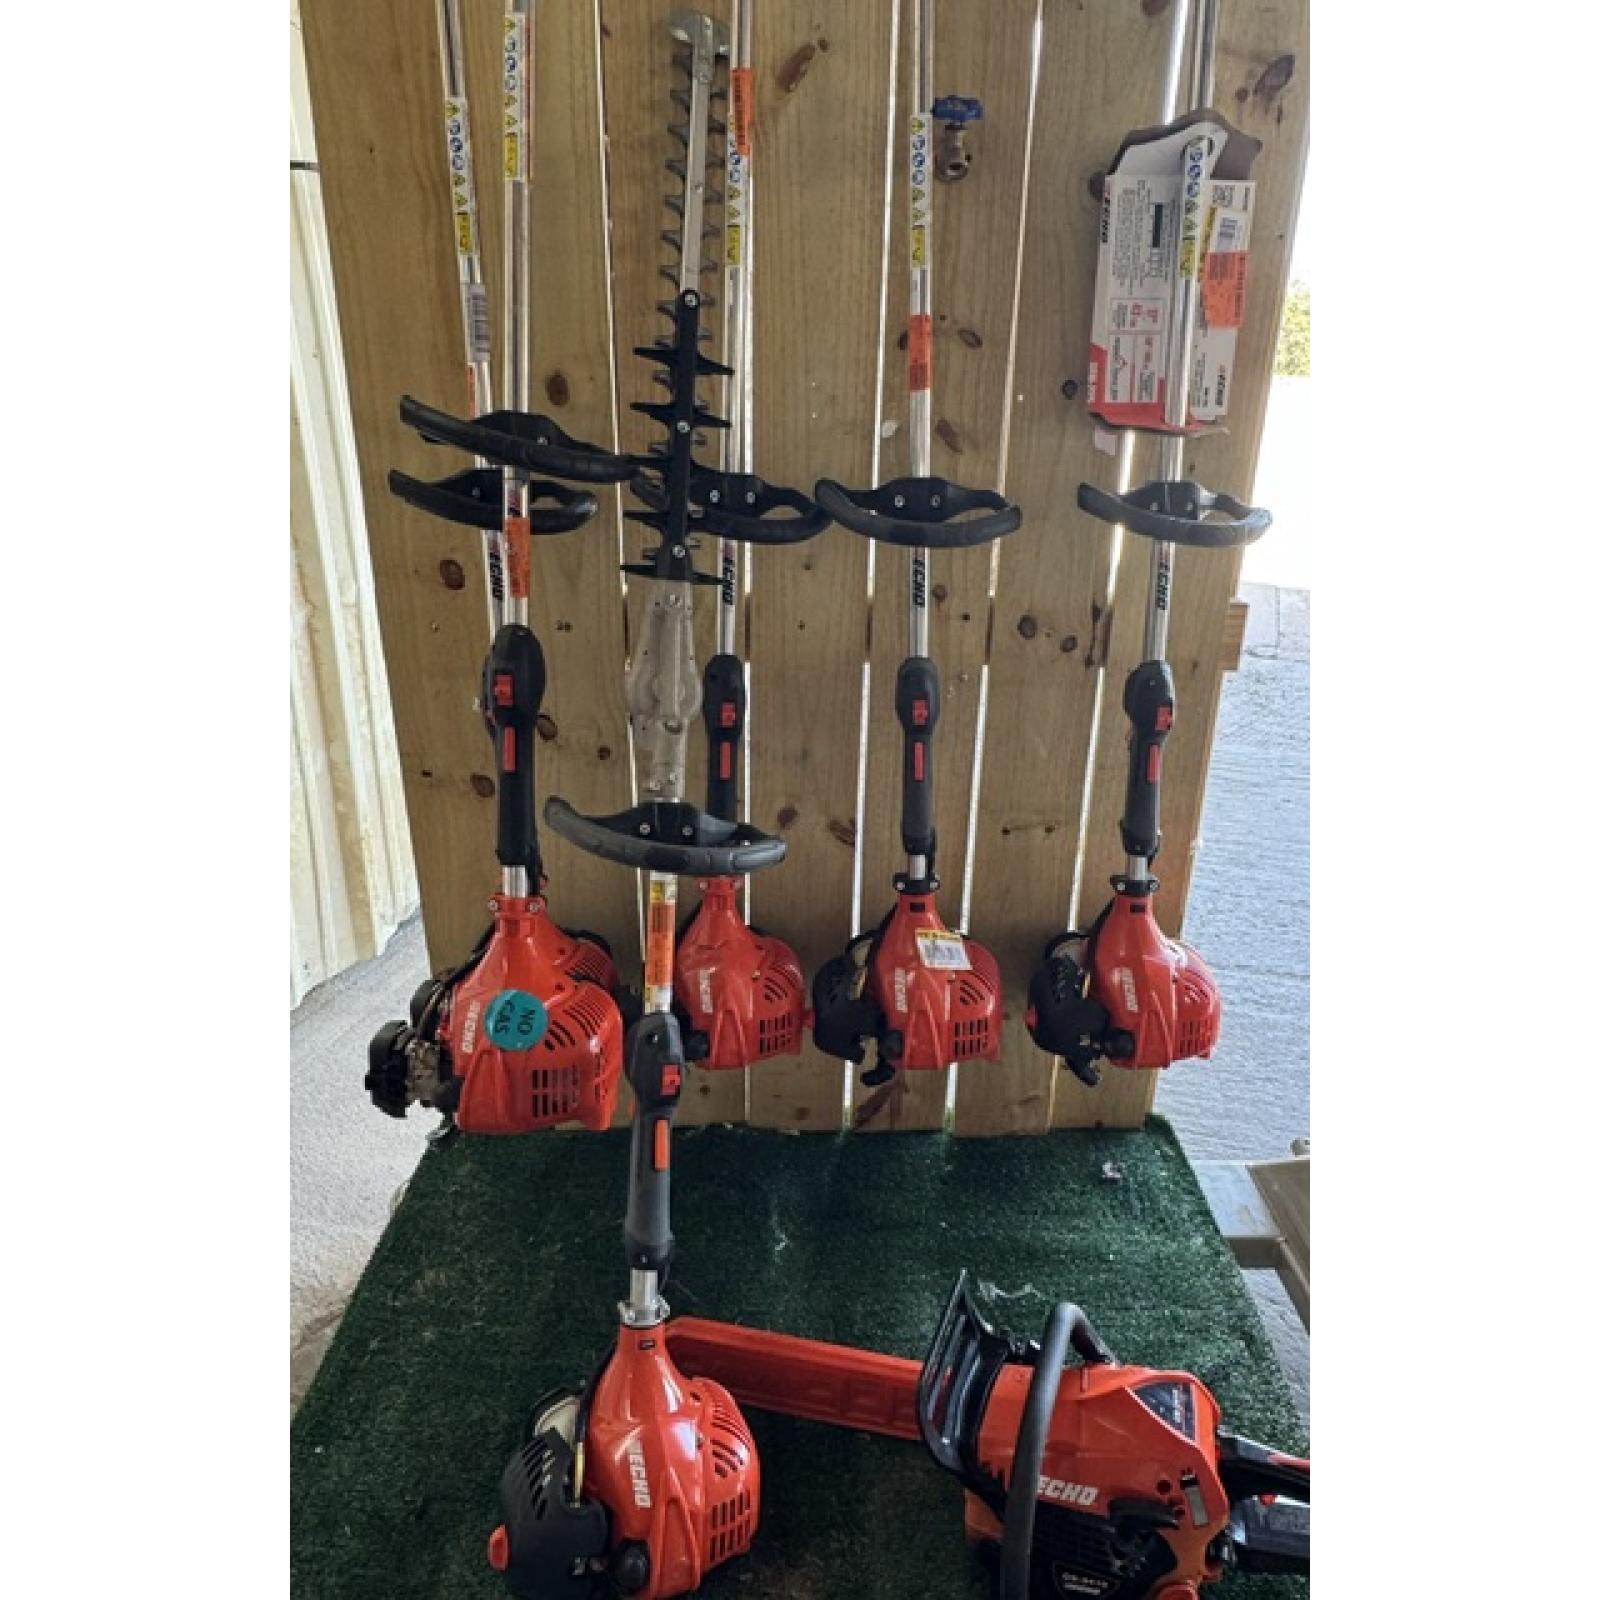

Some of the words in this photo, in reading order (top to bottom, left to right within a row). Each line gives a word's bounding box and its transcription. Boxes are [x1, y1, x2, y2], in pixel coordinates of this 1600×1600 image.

[489, 551, 504, 601] ECHO
[723, 557, 736, 606] ECHO
[912, 558, 926, 608] ECHO
[1156, 561, 1171, 611] ECHO
[461, 1009, 479, 1054] ECHO
[517, 1009, 536, 1036] NO
[628, 1452, 651, 1509] ECHO
[1036, 1475, 1099, 1506] ECHO
